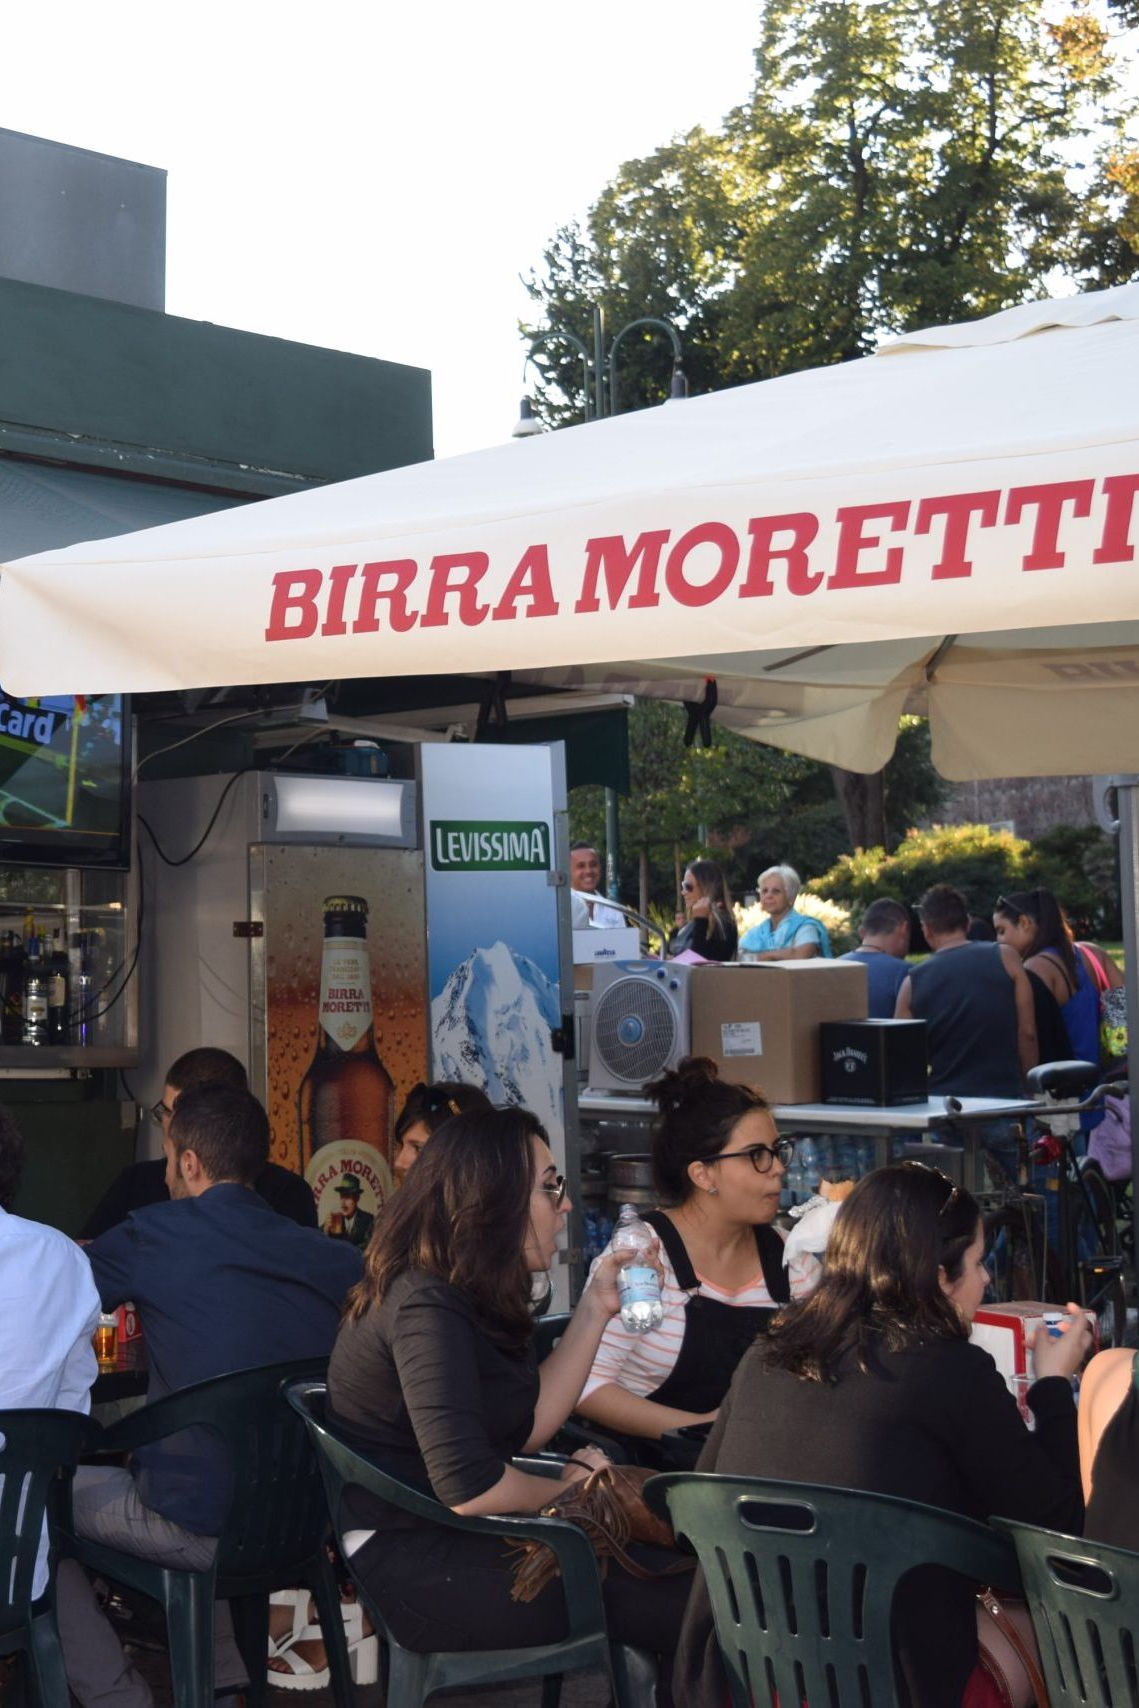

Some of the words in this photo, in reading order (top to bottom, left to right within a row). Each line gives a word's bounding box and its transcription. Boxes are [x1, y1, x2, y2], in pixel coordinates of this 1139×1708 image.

[265, 544, 559, 641] BIRRA
[576, 474, 1139, 613] MORETTI
[435, 828, 545, 864] LEVISSIMA
[328, 988, 366, 1000] BIRRA
[321, 1001, 371, 1013] MORETTI
